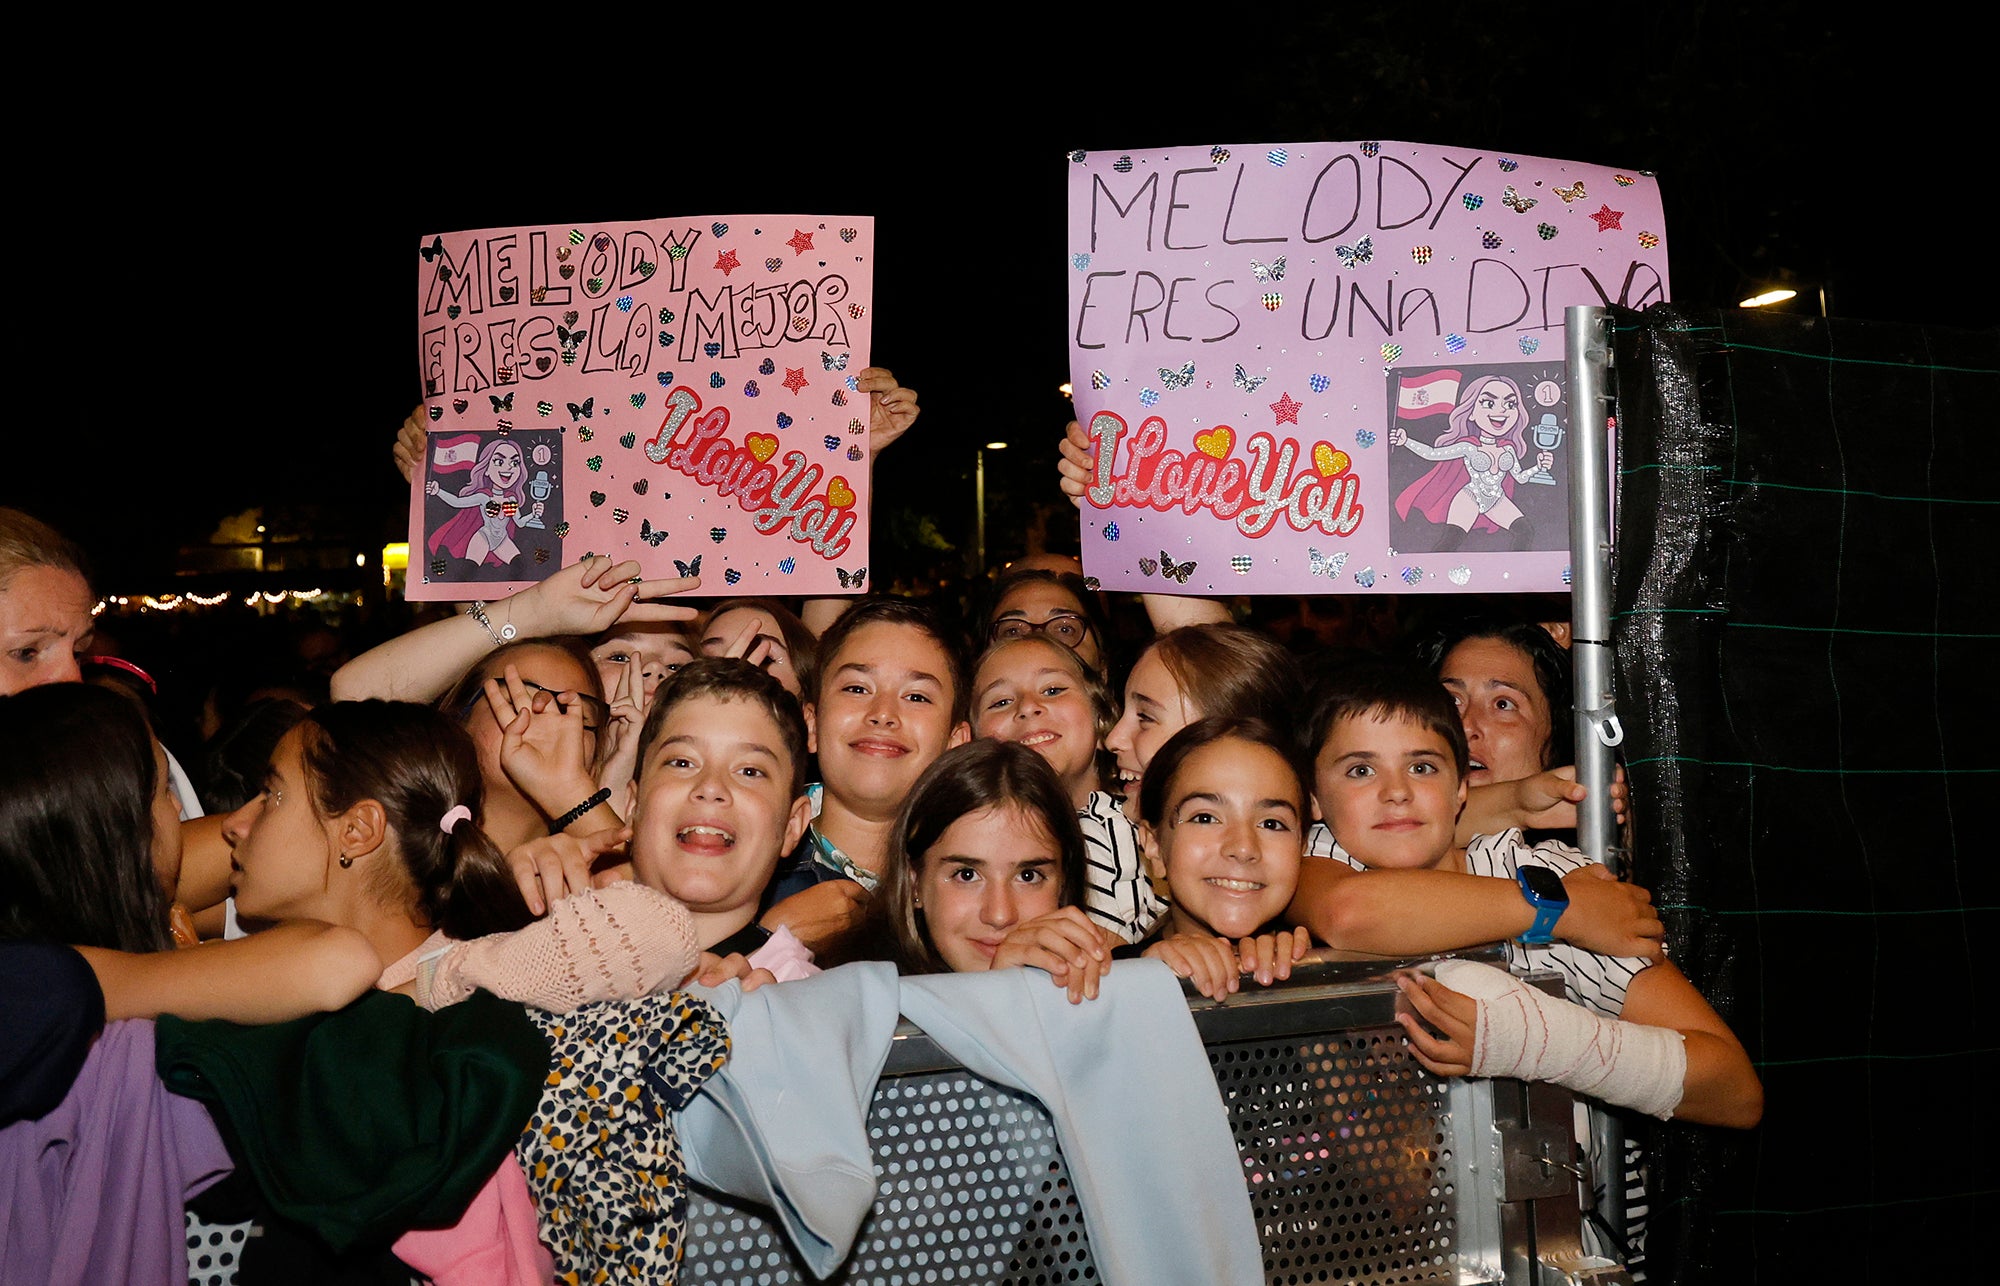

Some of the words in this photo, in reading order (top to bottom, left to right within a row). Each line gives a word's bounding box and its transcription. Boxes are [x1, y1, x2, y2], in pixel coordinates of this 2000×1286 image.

[1090, 152, 1483, 254] MELODY
[423, 227, 703, 317] MELODY
[1075, 269, 1241, 350] ERES
[422, 315, 559, 399] ERES
[580, 302, 654, 379] LA
[677, 274, 852, 363] MEJOR
[645, 387, 700, 464] I
[669, 407, 774, 510] Love
[1087, 412, 1126, 507] I
[1115, 418, 1245, 518] Love
[1236, 435, 1363, 535] You
[753, 452, 855, 559] You
